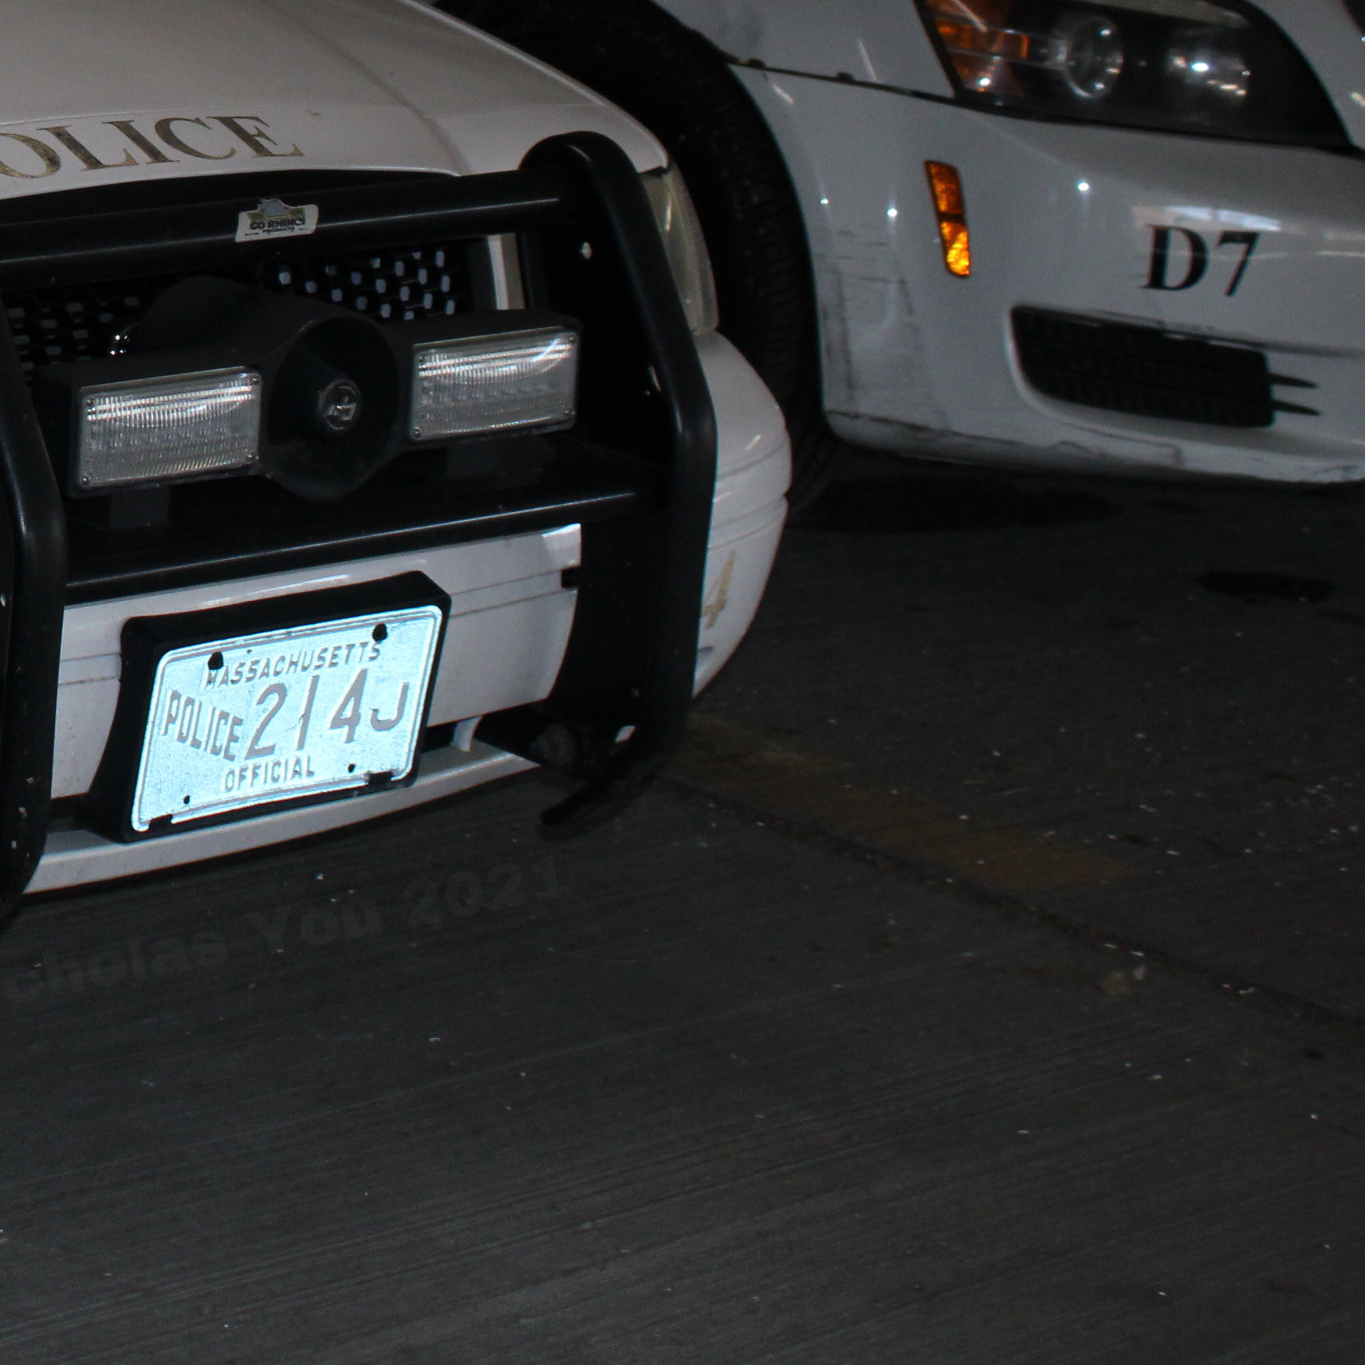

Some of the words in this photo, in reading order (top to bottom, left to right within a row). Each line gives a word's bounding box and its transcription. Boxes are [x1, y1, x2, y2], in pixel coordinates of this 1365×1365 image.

[1140, 224, 1261, 296] D7
[206, 641, 380, 688] MASSACHUSETTS
[166, 690, 244, 761] POLICE
[226, 756, 315, 792] OFFICIAL
